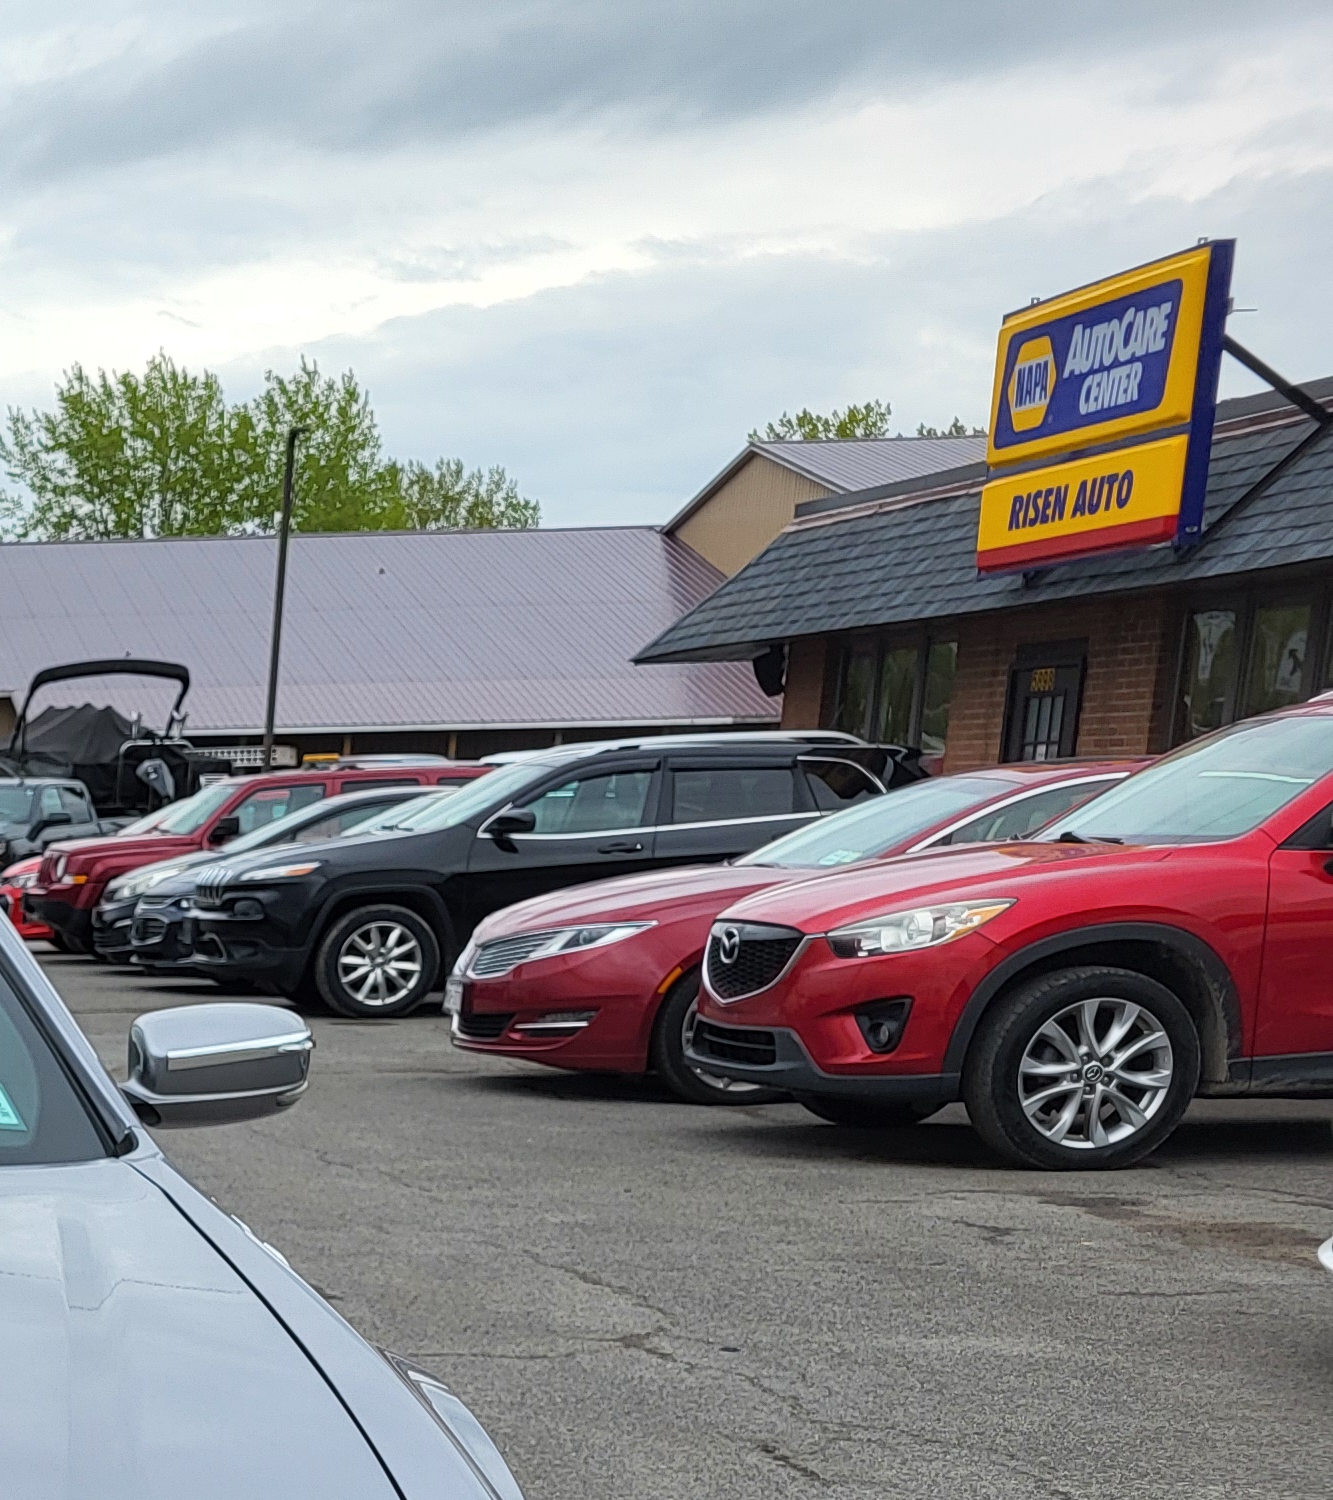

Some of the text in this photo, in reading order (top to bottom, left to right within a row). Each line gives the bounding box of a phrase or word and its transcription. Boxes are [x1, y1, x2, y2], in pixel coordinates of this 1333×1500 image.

[1014, 359, 1050, 409] NAPA
[1078, 361, 1143, 416] CENTER
[1007, 469, 1134, 532] RISEN AUTO
